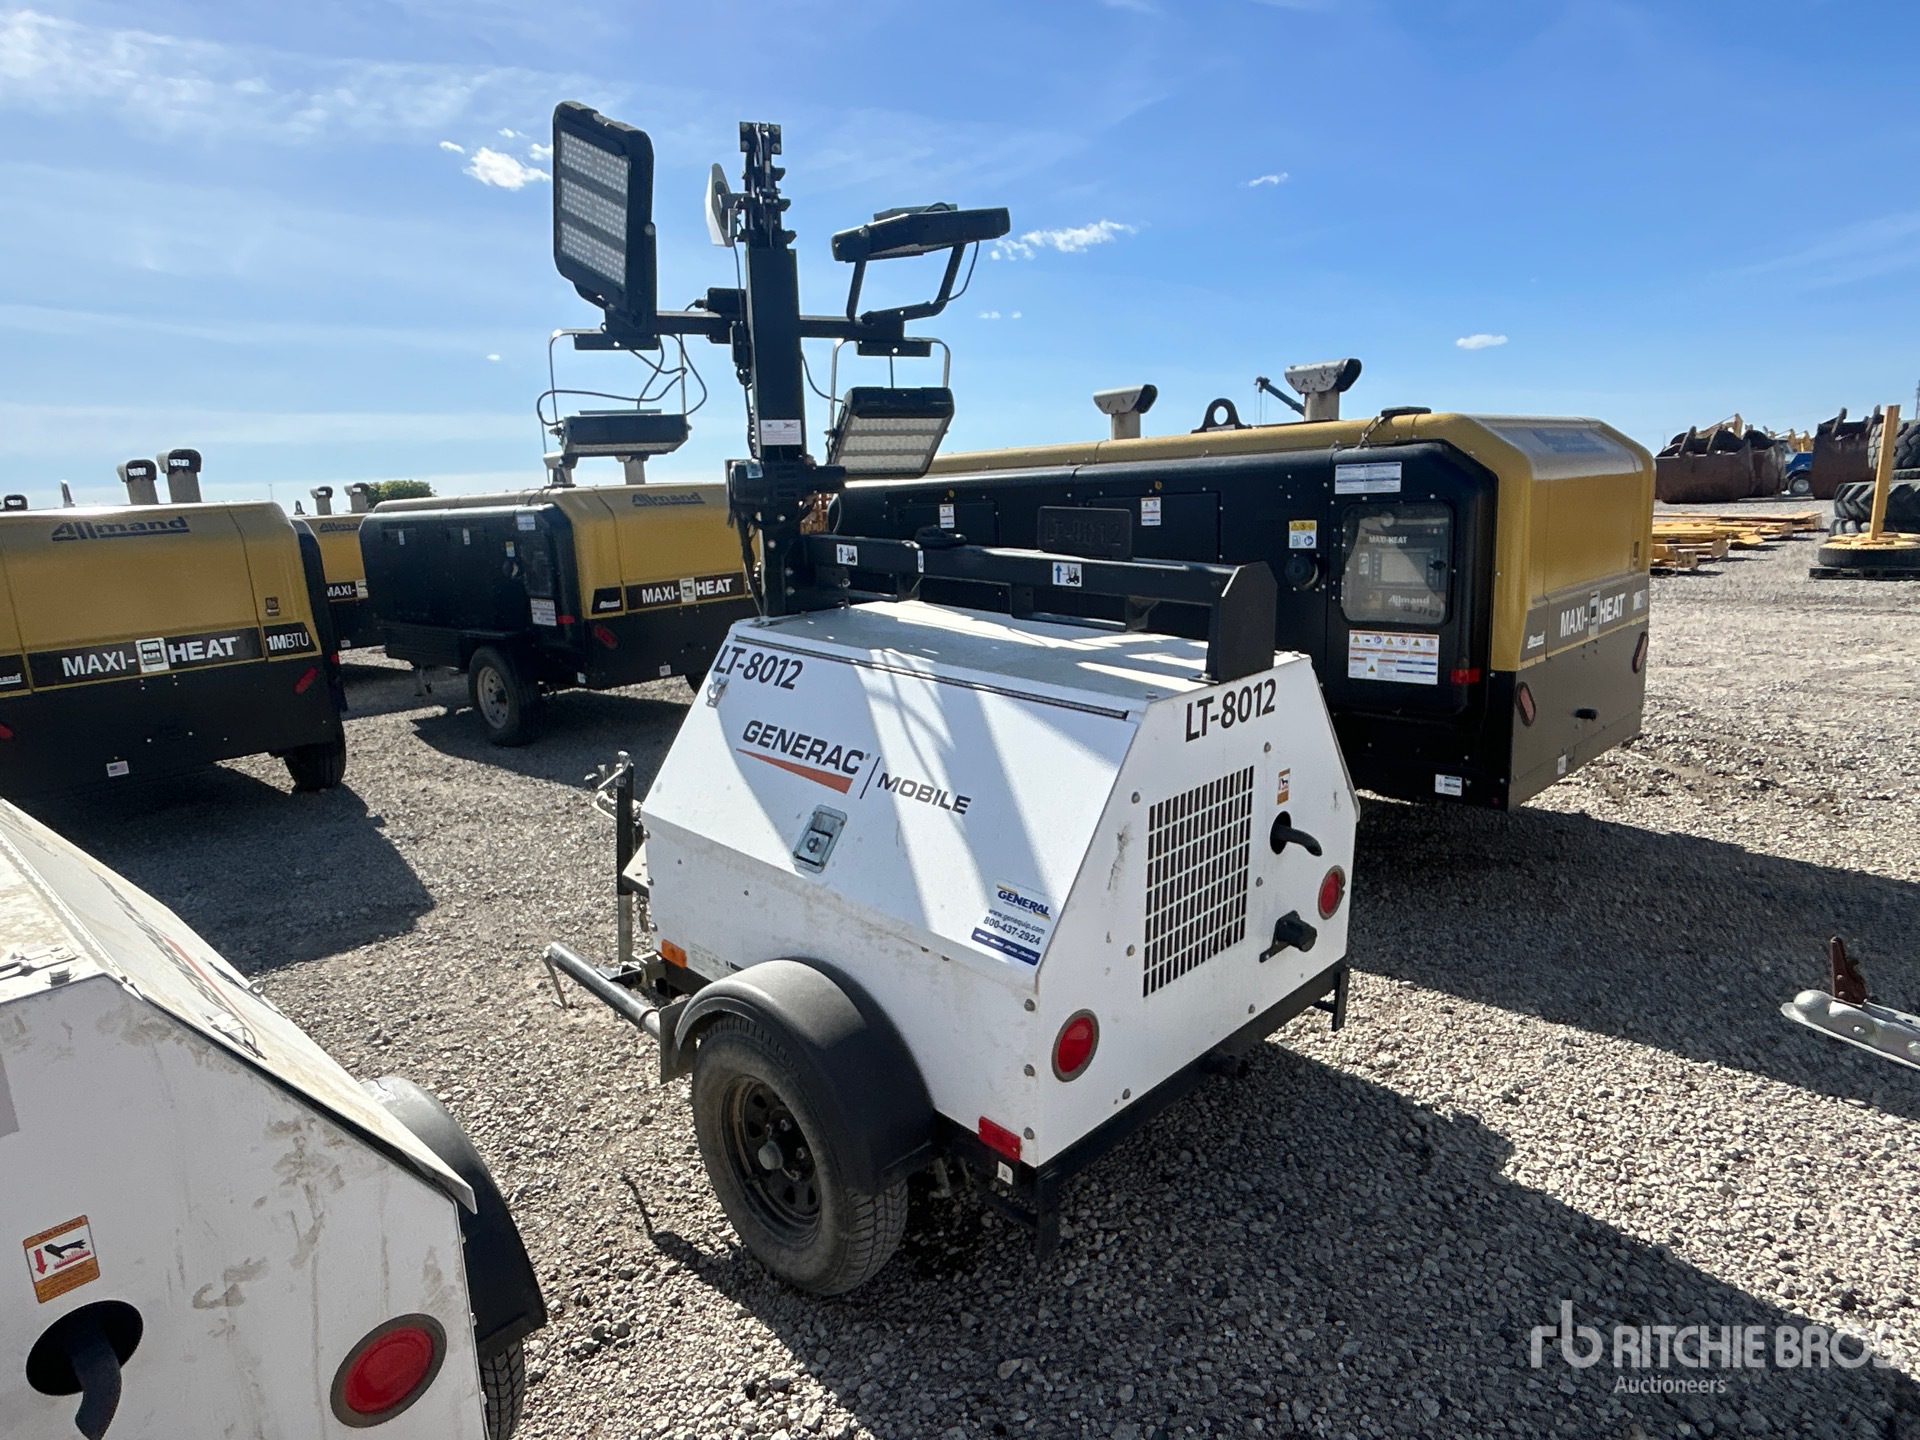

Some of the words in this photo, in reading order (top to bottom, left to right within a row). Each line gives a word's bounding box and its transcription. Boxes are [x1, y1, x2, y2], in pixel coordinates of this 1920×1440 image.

[52, 516, 190, 541] Allmand
[641, 585, 680, 604] MAXI-
[695, 578, 733, 596] HEAT
[1560, 605, 1588, 638] MAXI-
[1599, 592, 1626, 624] HEAT
[62, 650, 137, 678] MAXI-
[168, 636, 237, 664] HEAT
[714, 645, 803, 690] LT-8012
[1186, 678, 1276, 743] LT-8012
[742, 719, 864, 775] GENERAC
[877, 772, 972, 815] MOBILE
[988, 908, 1045, 935] www.genequip.com
[998, 890, 1049, 916] GENERAL
[984, 916, 1041, 944] 800-437-2924
